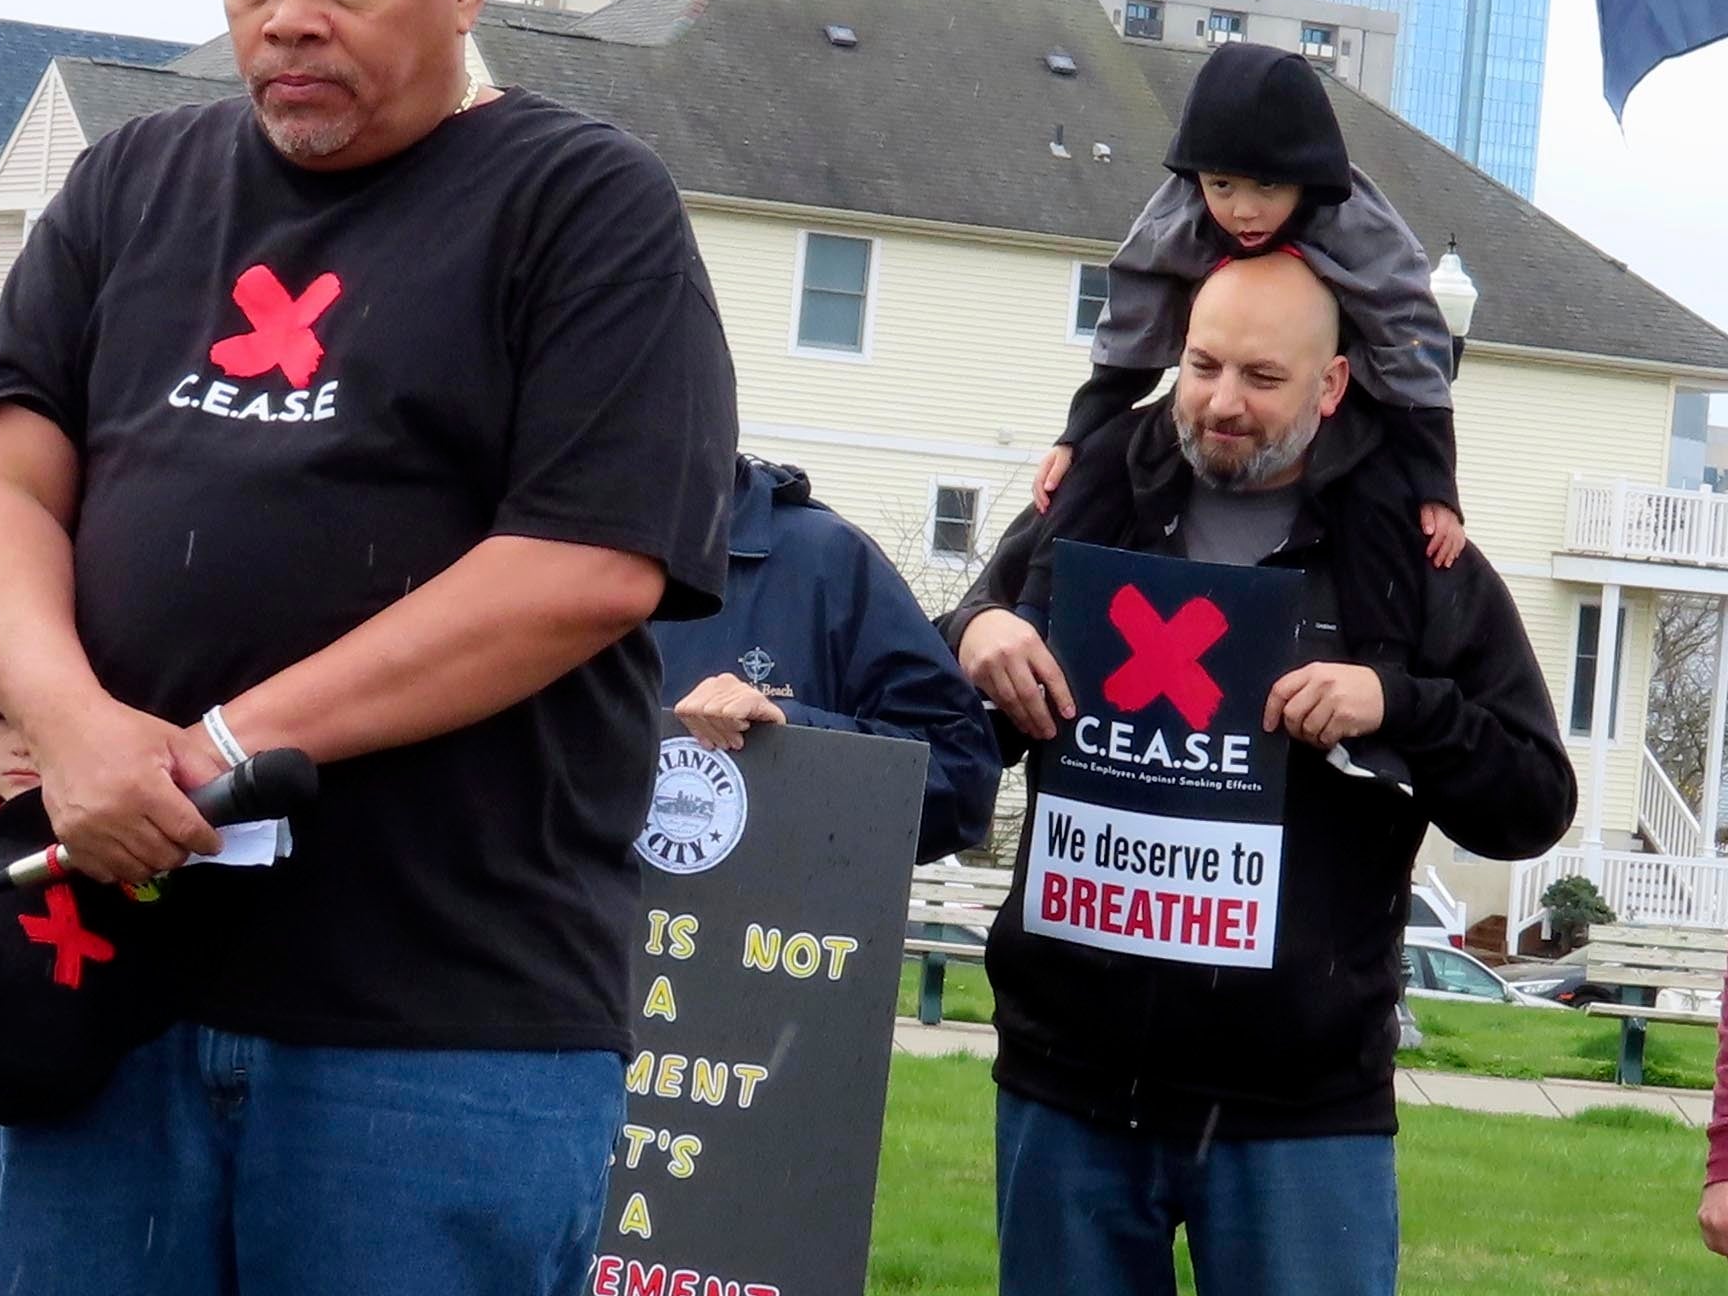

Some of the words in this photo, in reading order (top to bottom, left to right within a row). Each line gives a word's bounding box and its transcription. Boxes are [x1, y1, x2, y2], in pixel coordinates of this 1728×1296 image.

[168, 374, 339, 422] C.E.A.S.E
[1075, 715, 1251, 774] C.E.A.S.E
[657, 749, 733, 796] LANTIC
[1060, 755, 1088, 770] Casino
[1090, 762, 1136, 780] Employees
[1138, 772, 1176, 785] Against
[1179, 776, 1222, 791] Smoking
[1225, 779, 1262, 792] Effects
[648, 833, 706, 865] CITY
[1047, 810, 1085, 863] We
[1095, 822, 1221, 884] deserve
[1231, 841, 1265, 887] to
[1040, 870, 1261, 951] BREATHE!
[645, 908, 699, 960] IS
[743, 922, 859, 982] NOT
[643, 975, 678, 1023] A
[608, 1124, 703, 1180] T'S
[619, 1192, 652, 1240] A
